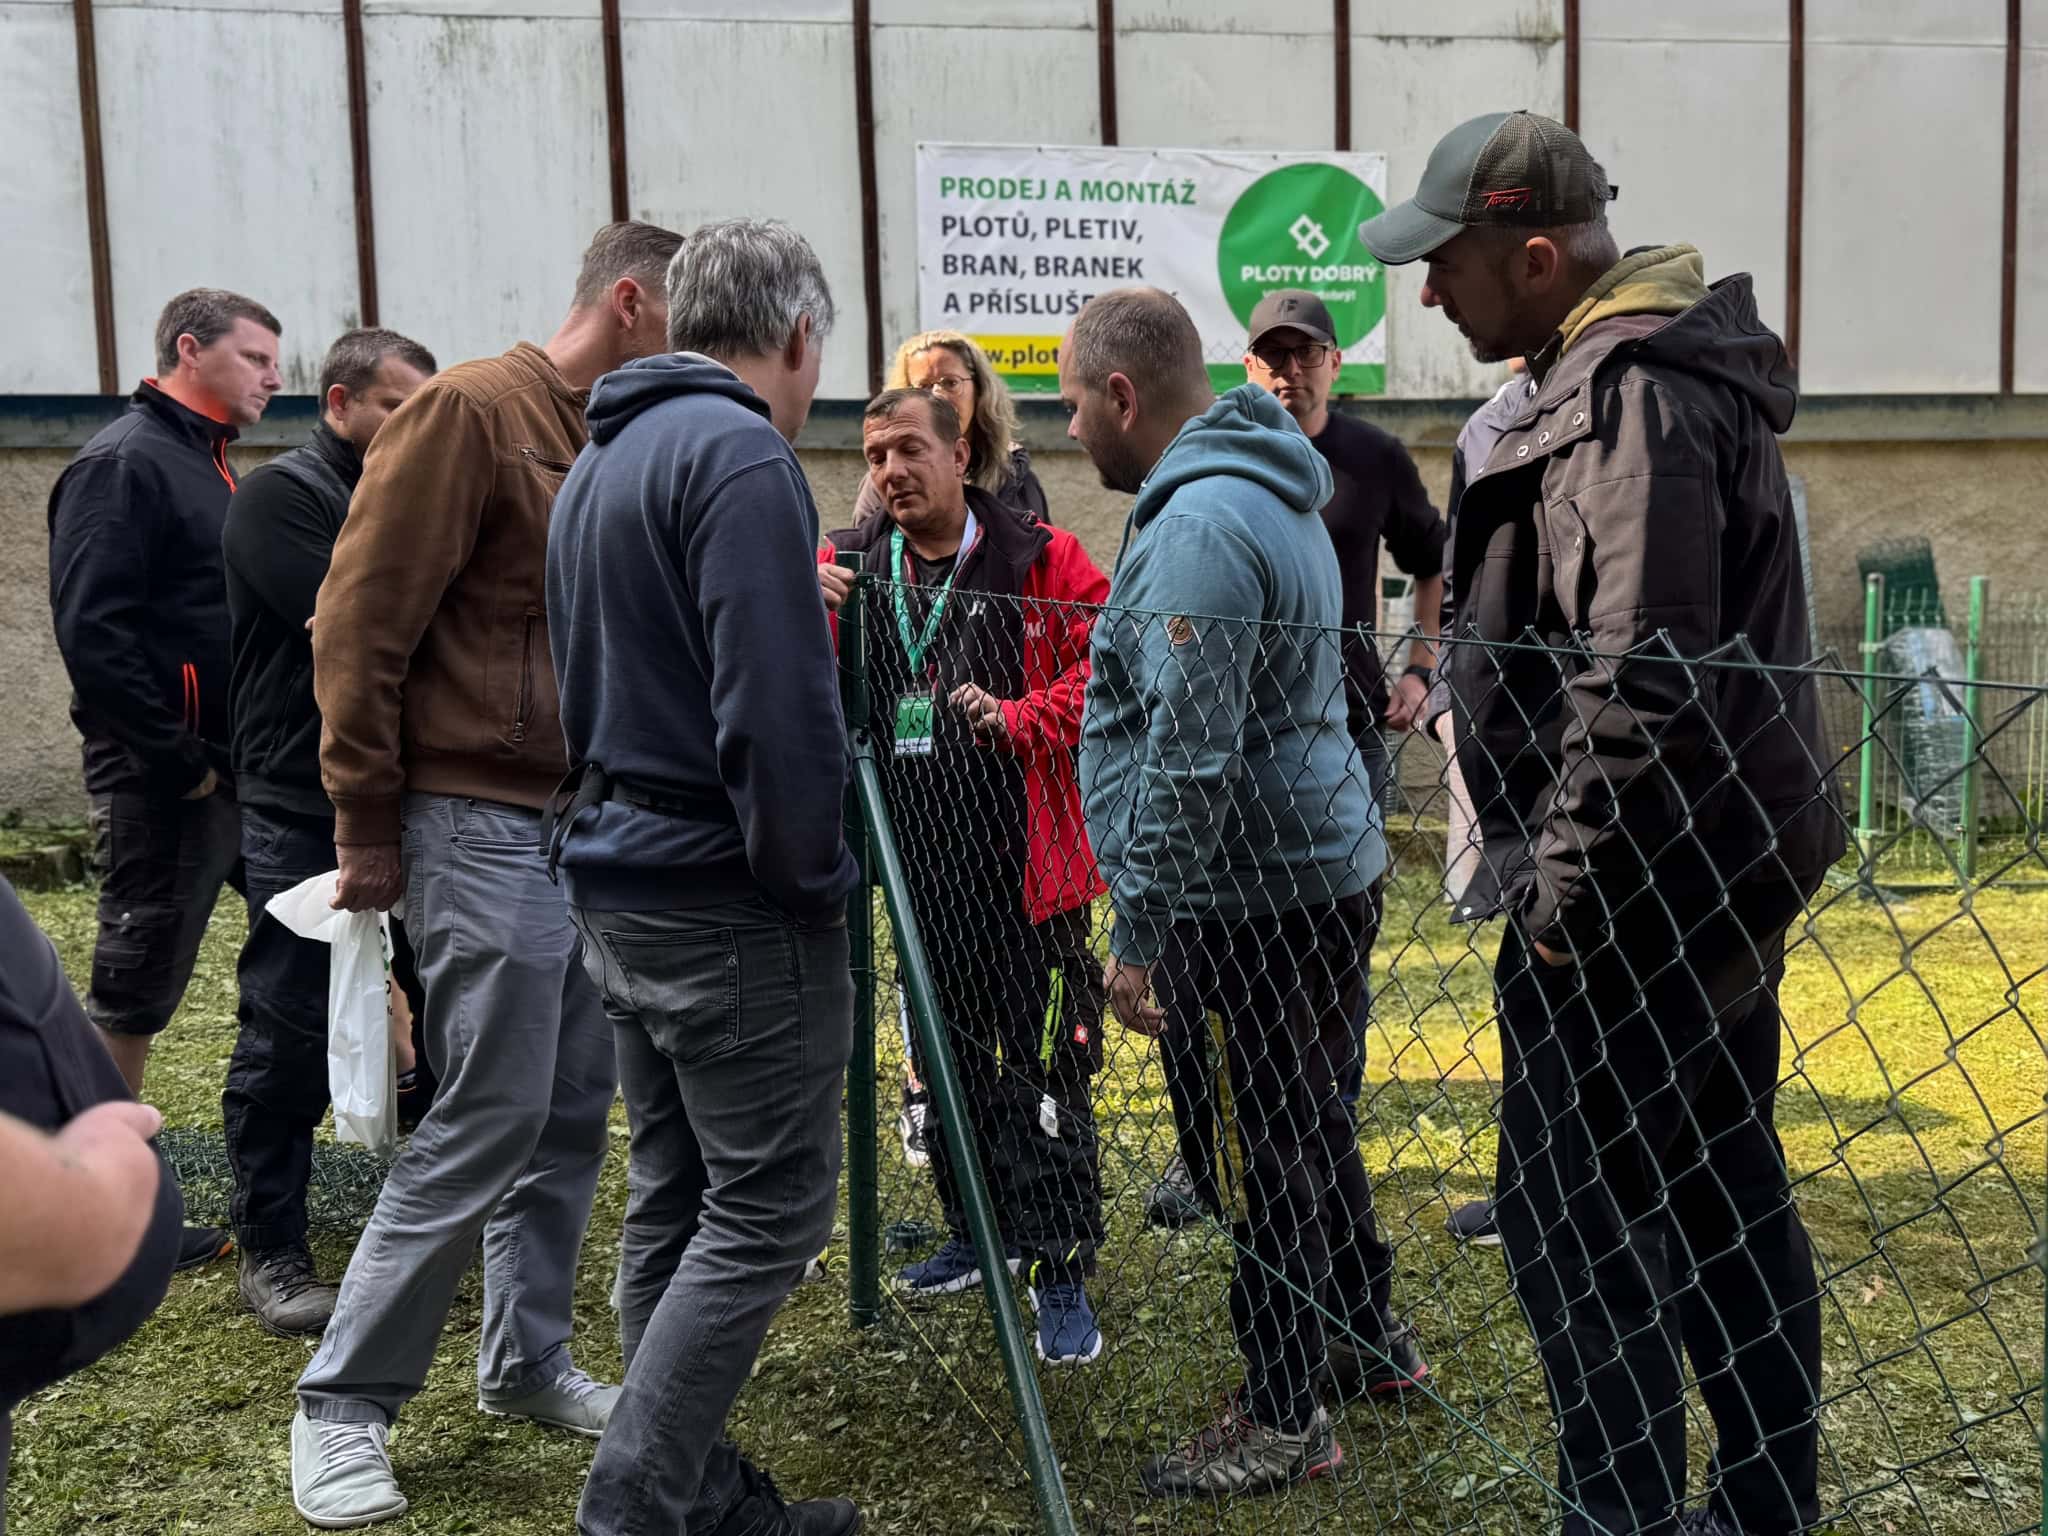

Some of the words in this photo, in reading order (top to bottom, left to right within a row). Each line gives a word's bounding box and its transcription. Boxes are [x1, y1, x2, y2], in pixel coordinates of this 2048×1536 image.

[941, 177, 1047, 200] PRODEJ
[1055, 179, 1072, 201] A
[1080, 178, 1196, 205] MONTÁŽ
[942, 210, 1037, 241] PLOTŮ,
[1045, 218, 1143, 244] PLETIV,
[942, 254, 1026, 280] BRAN,
[1034, 256, 1144, 279] BRANEK
[1241, 265, 1306, 283] PLOTY
[1310, 262, 1378, 283] DOBRÝ
[943, 292, 961, 313] A
